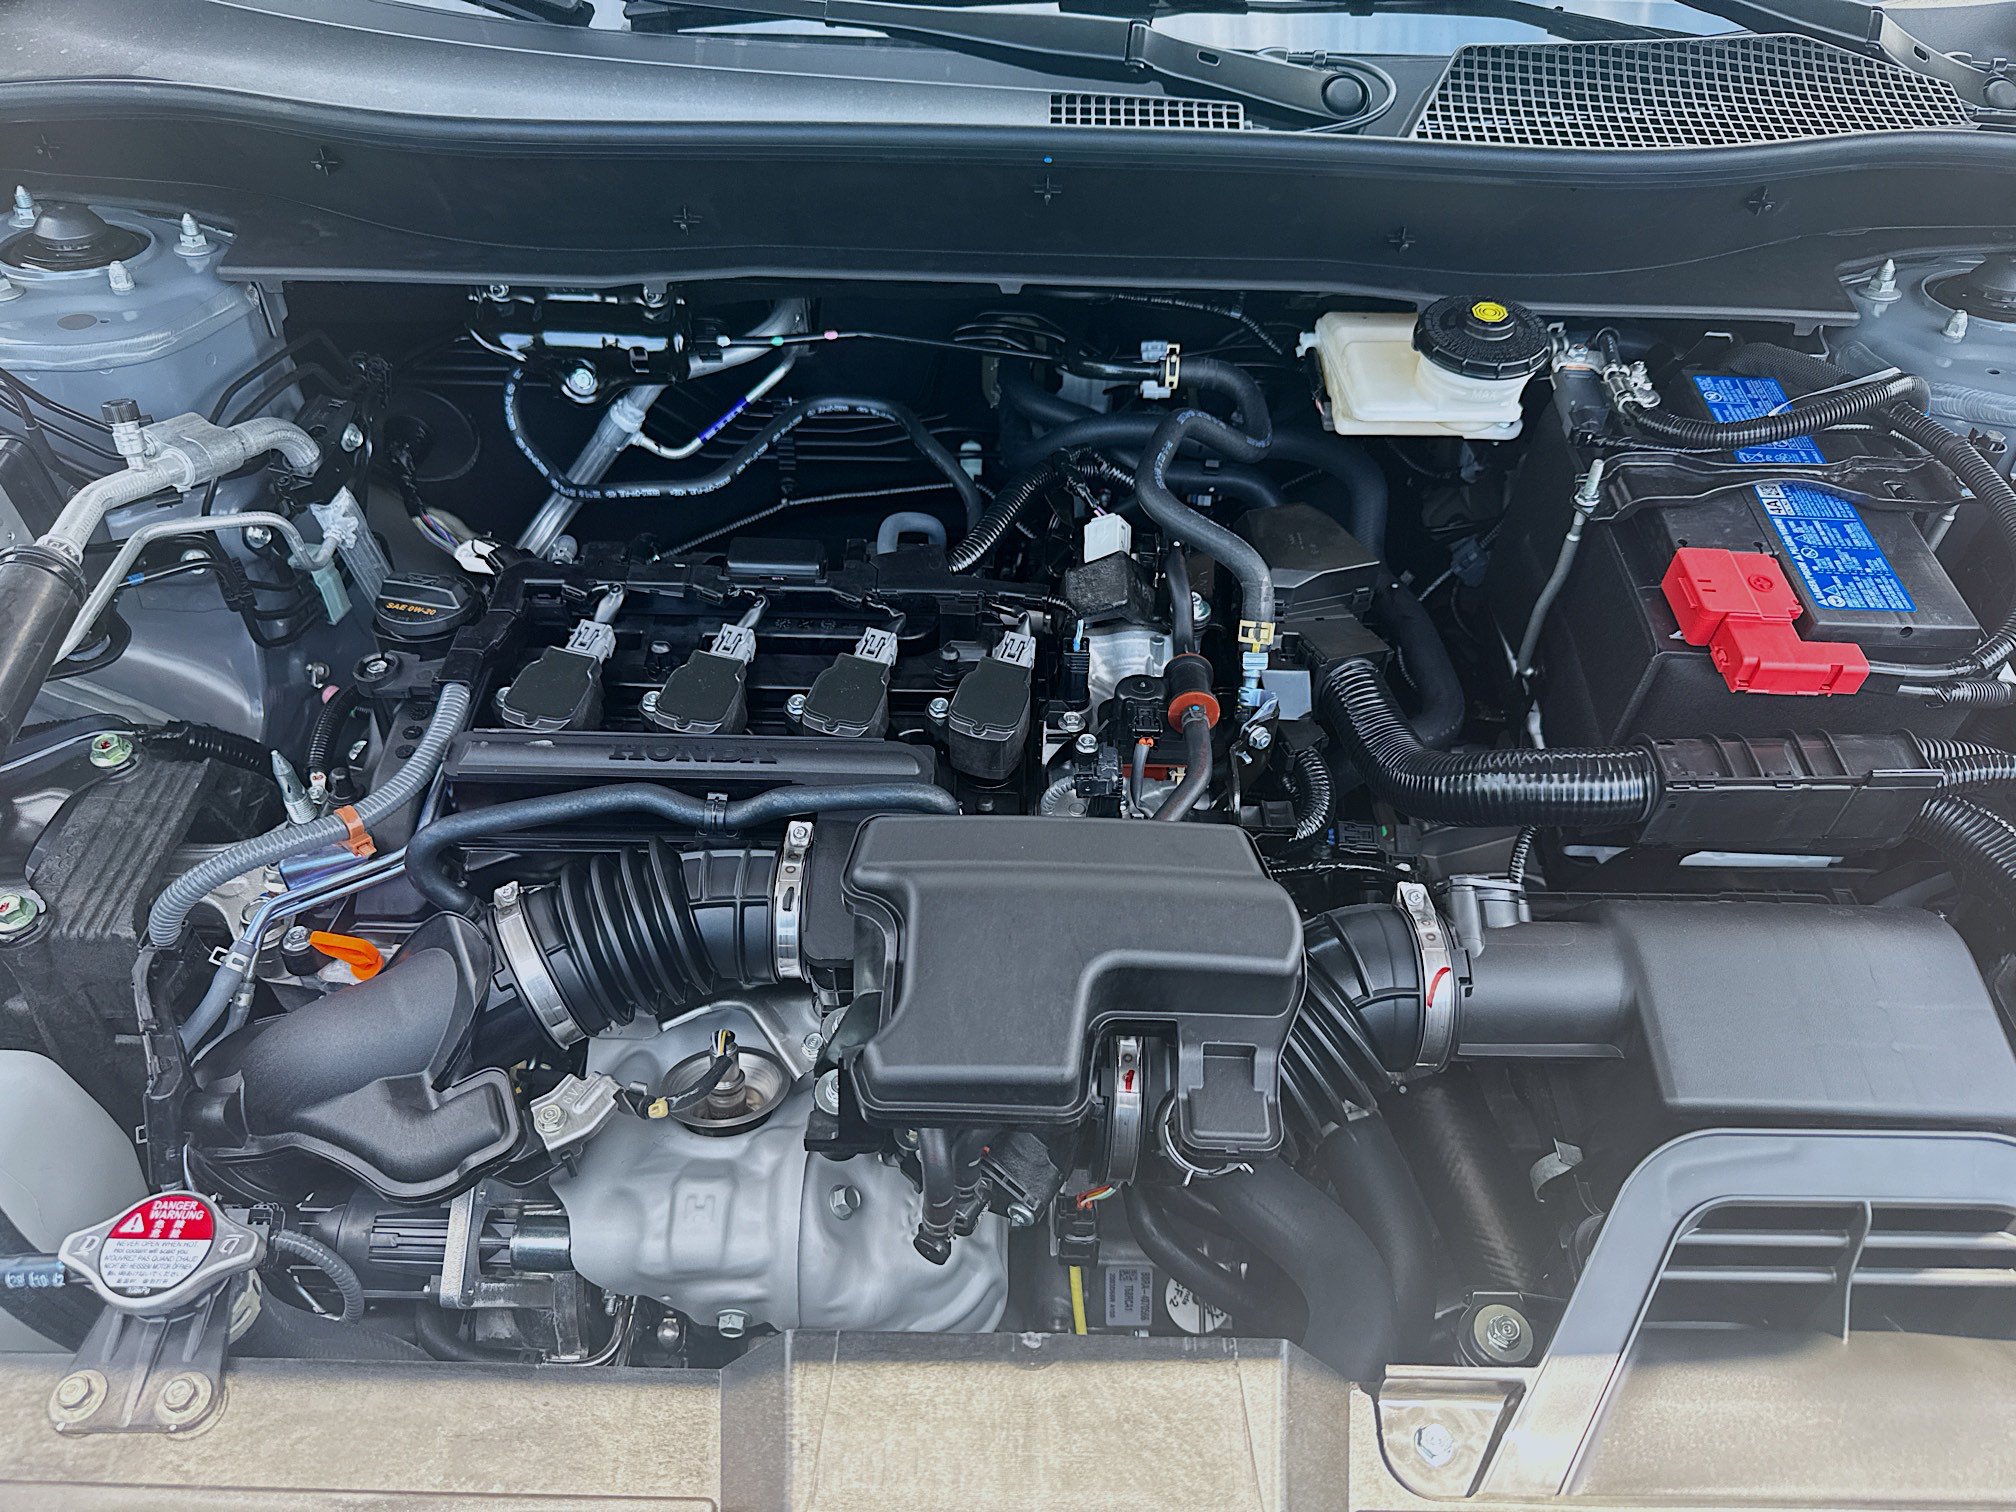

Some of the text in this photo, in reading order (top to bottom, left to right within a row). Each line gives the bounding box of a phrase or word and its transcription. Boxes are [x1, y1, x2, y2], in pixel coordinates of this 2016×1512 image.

[1470, 388, 1498, 400] MAX
[386, 602, 437, 616] SAE 0W-20
[608, 744, 777, 764] HONDA
[152, 1200, 199, 1210] DANGER
[149, 1210, 205, 1220] WARNUNG
